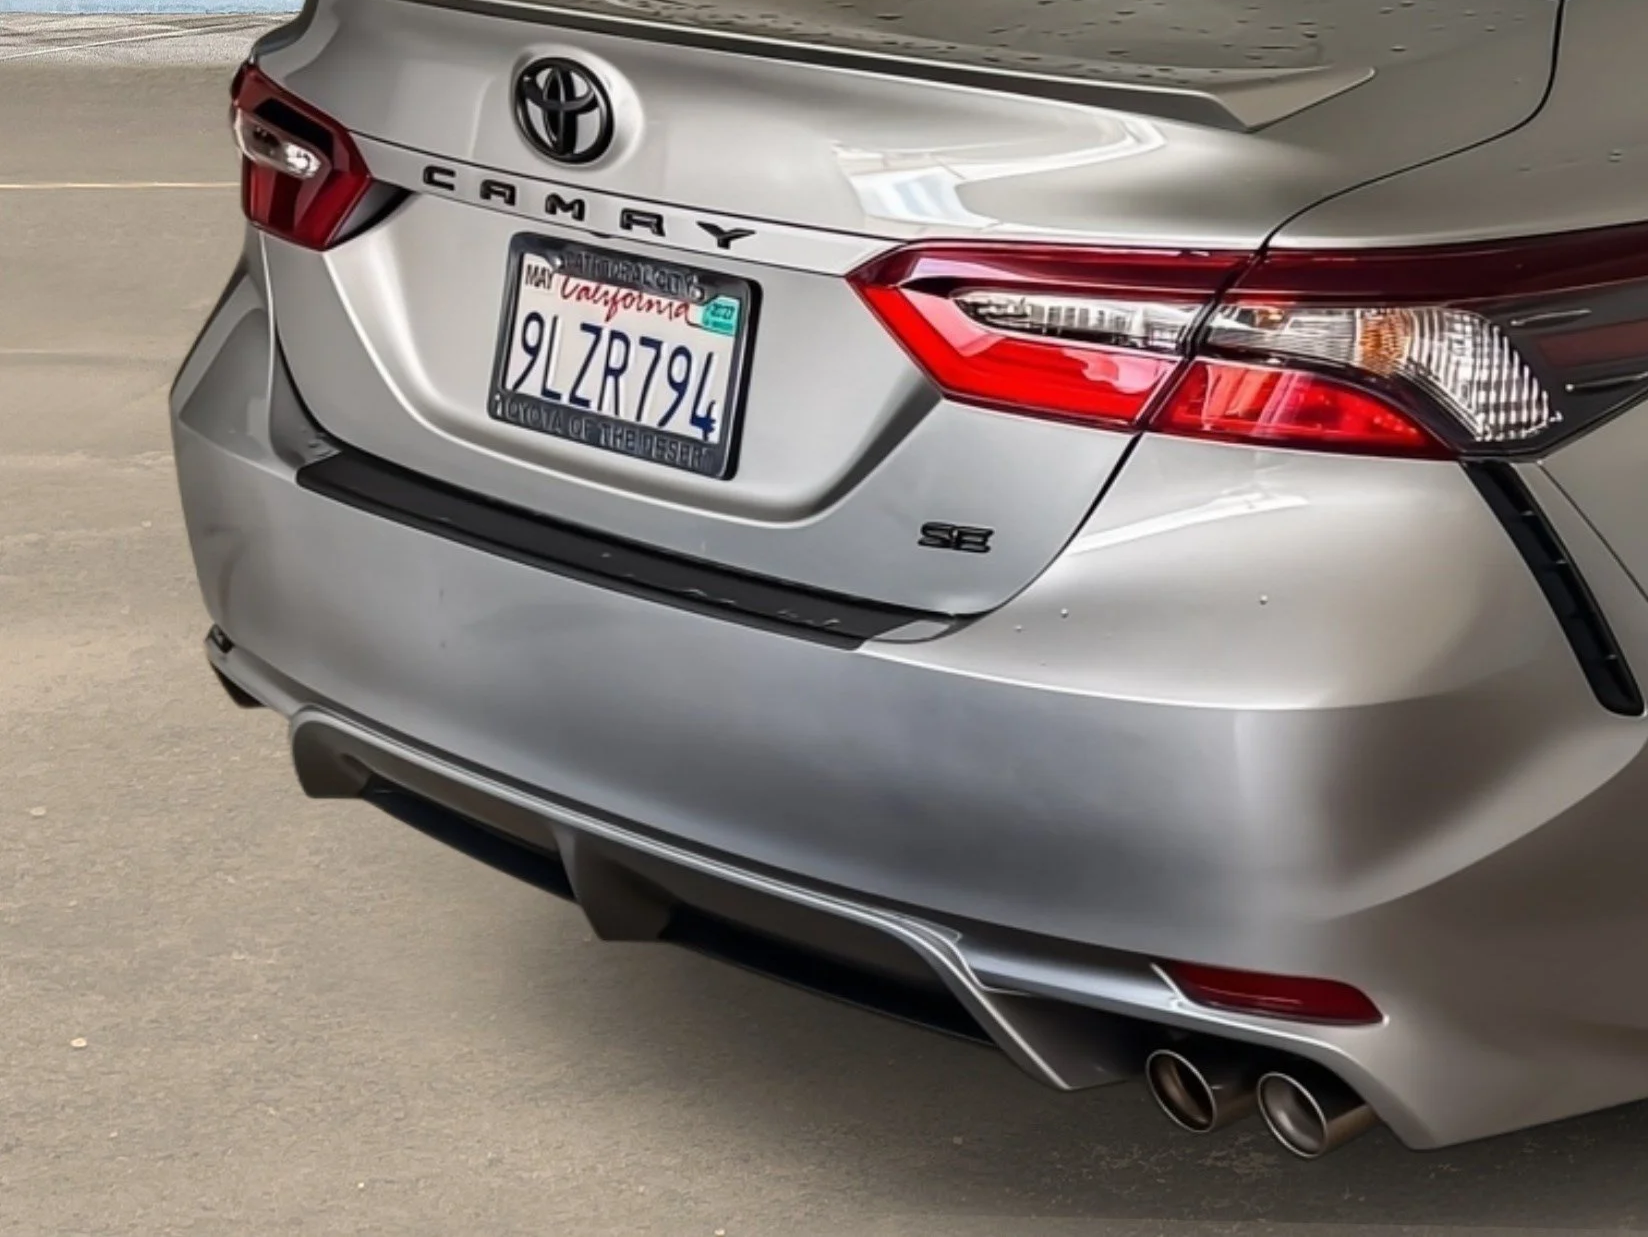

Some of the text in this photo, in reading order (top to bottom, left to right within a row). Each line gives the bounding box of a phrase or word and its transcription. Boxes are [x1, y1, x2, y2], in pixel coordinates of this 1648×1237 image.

[423, 164, 757, 250] CAMRY
[524, 264, 553, 290] MAY
[559, 274, 691, 322] California
[510, 311, 717, 442] 9LZR794
[493, 394, 562, 436] TOYOTA
[568, 417, 594, 441] OF
[598, 421, 637, 454] THE
[918, 521, 995, 554] SE
